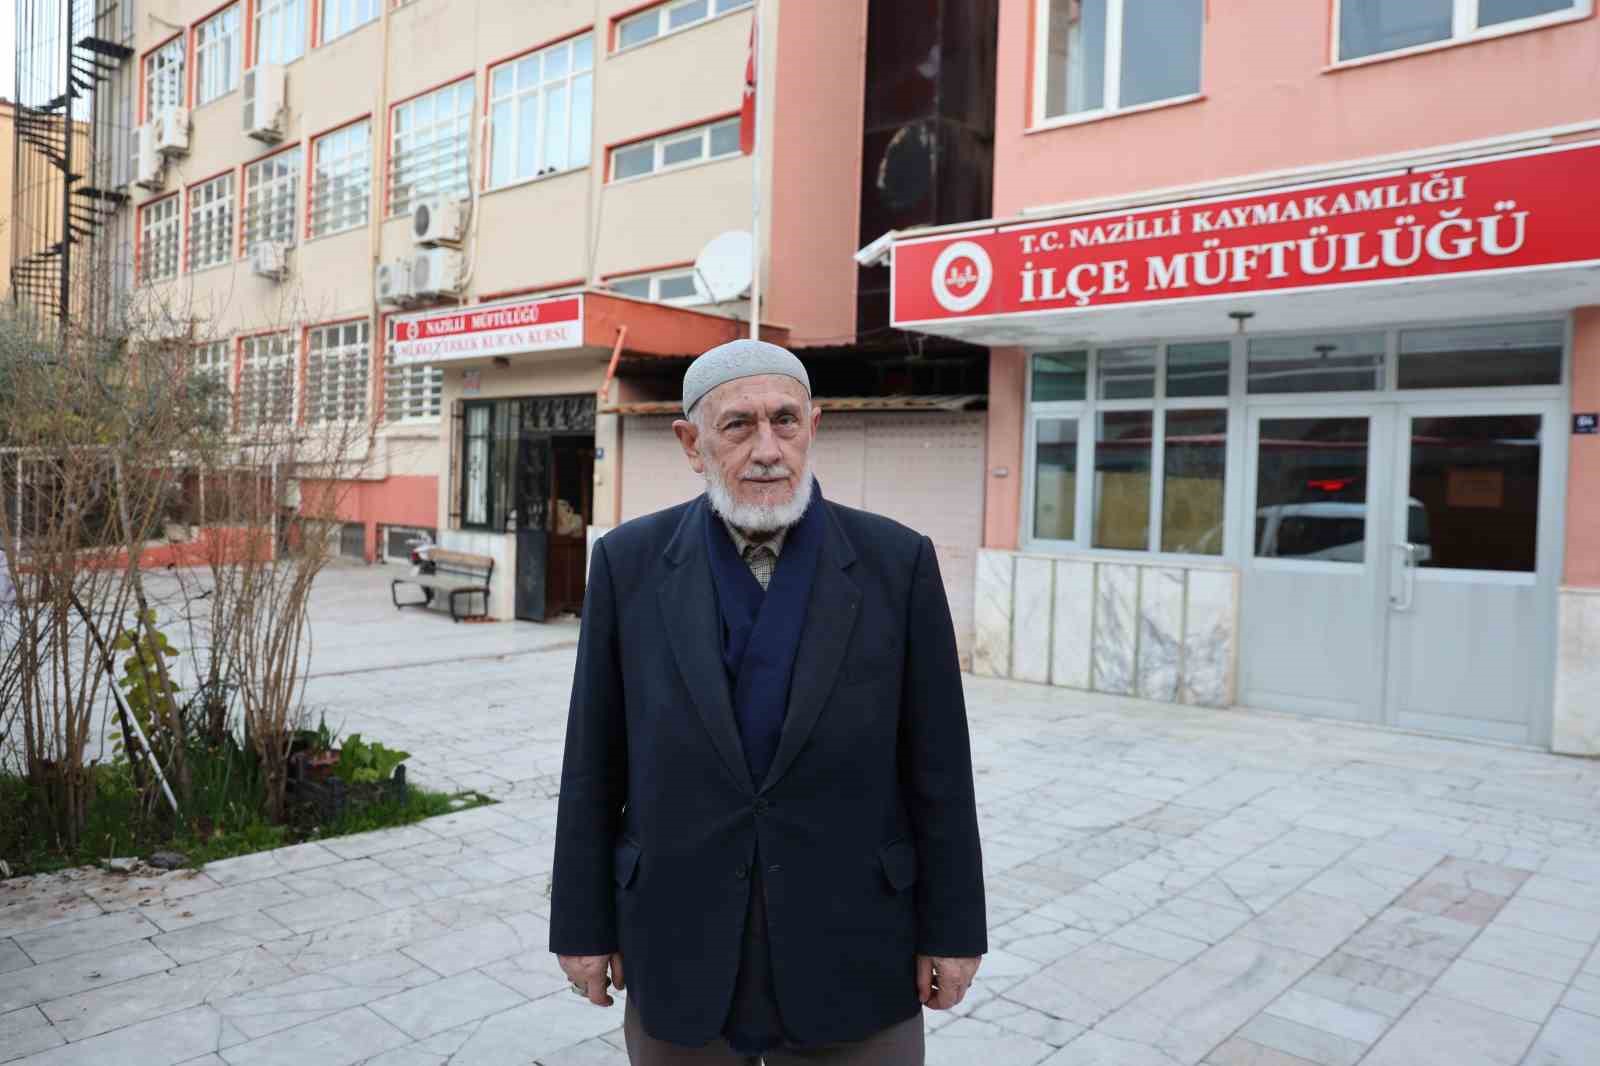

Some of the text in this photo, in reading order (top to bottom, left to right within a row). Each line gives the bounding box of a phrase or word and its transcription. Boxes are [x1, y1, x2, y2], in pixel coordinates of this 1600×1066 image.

[1019, 172, 1467, 254] T.C. NAZİLLİ KAYMAKAMLIĞI
[1019, 200, 1529, 306] İLÇE MÜFTÜLÜĞÜ
